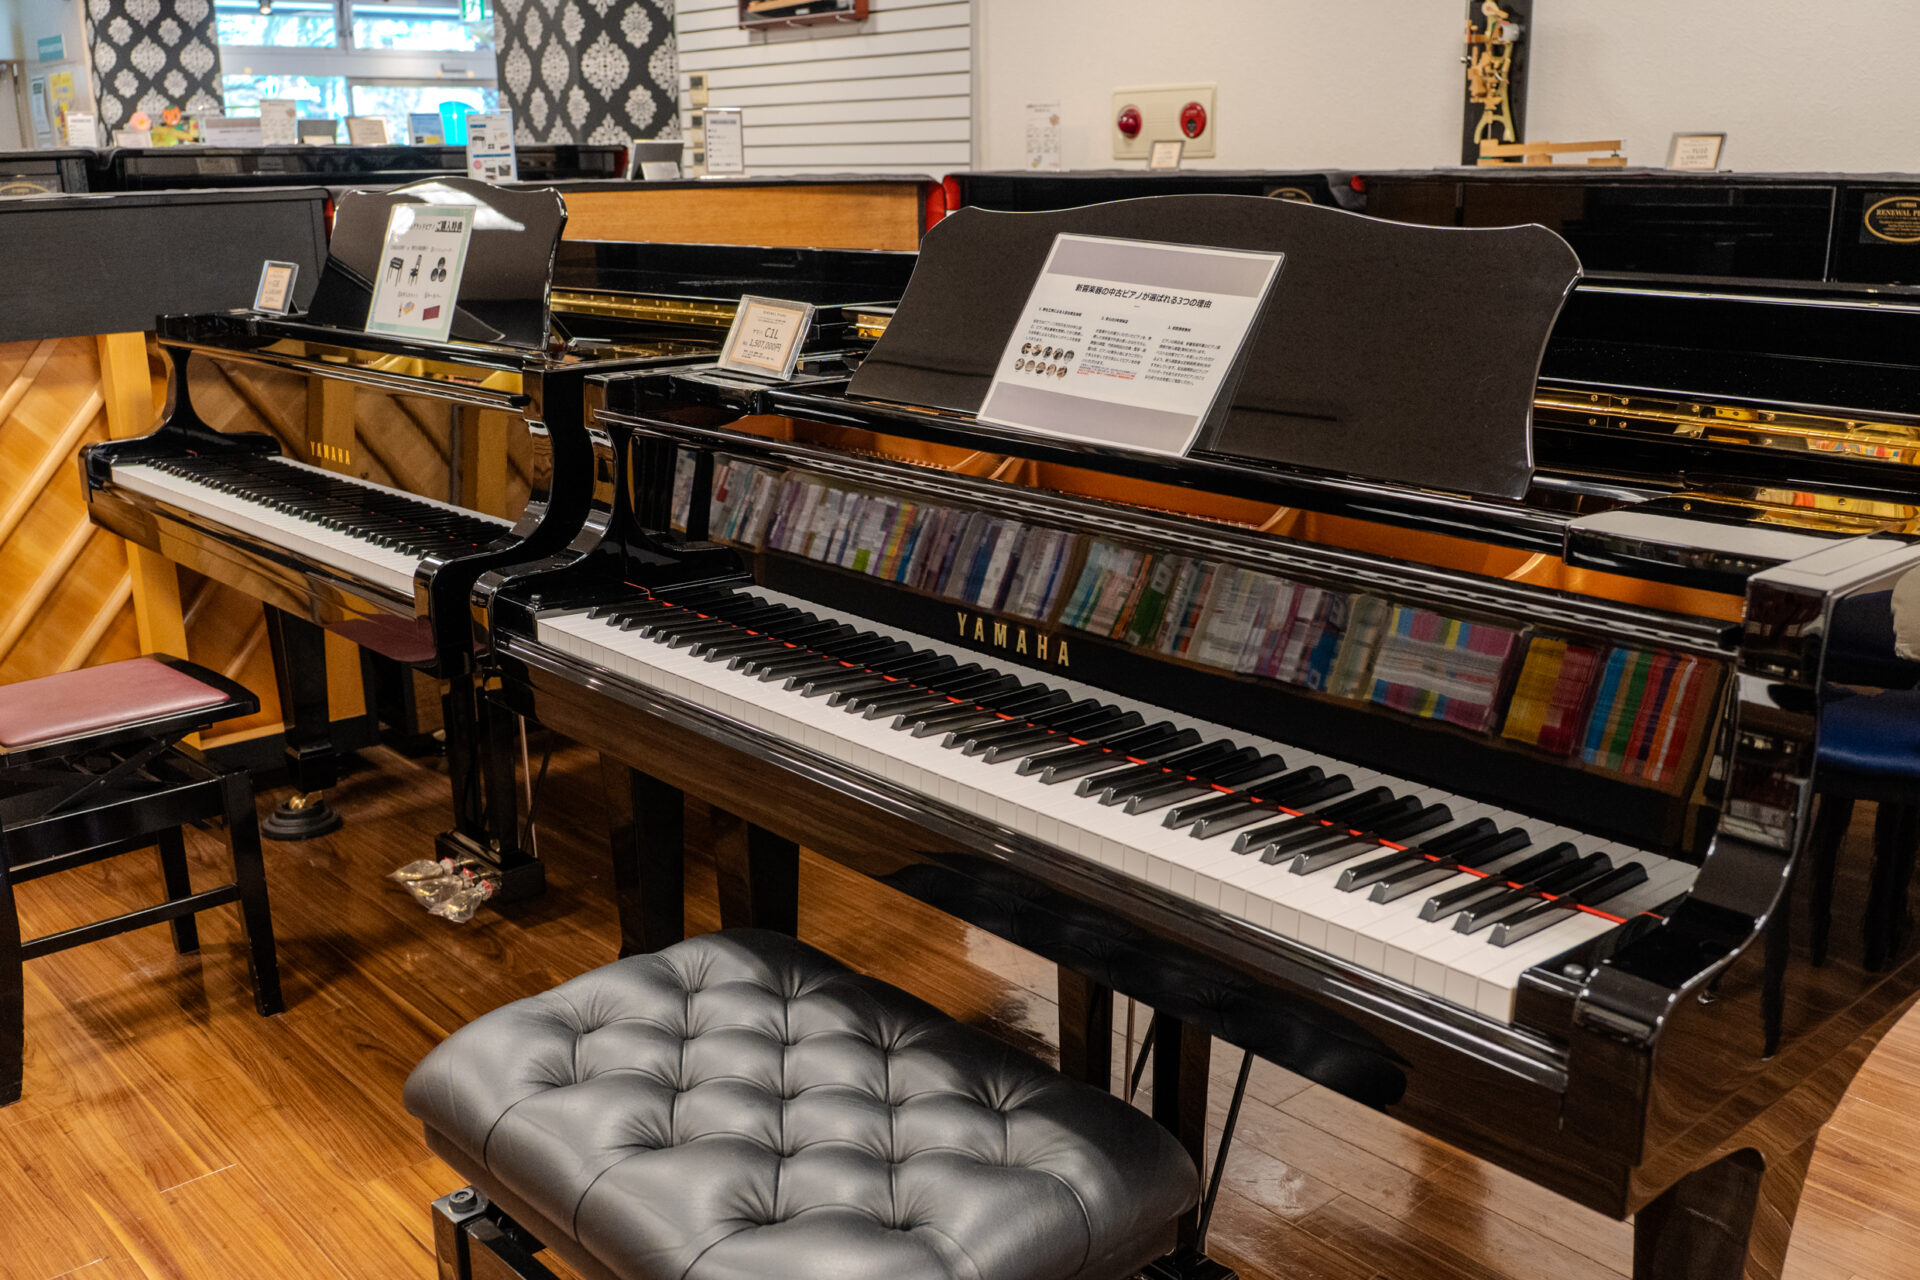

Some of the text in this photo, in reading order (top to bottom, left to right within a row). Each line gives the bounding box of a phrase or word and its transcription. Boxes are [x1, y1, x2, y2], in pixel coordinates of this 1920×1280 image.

[764, 327, 779, 339] C1L
[311, 441, 350, 465] YAMAHA
[957, 611, 1069, 667] YAMAHA
